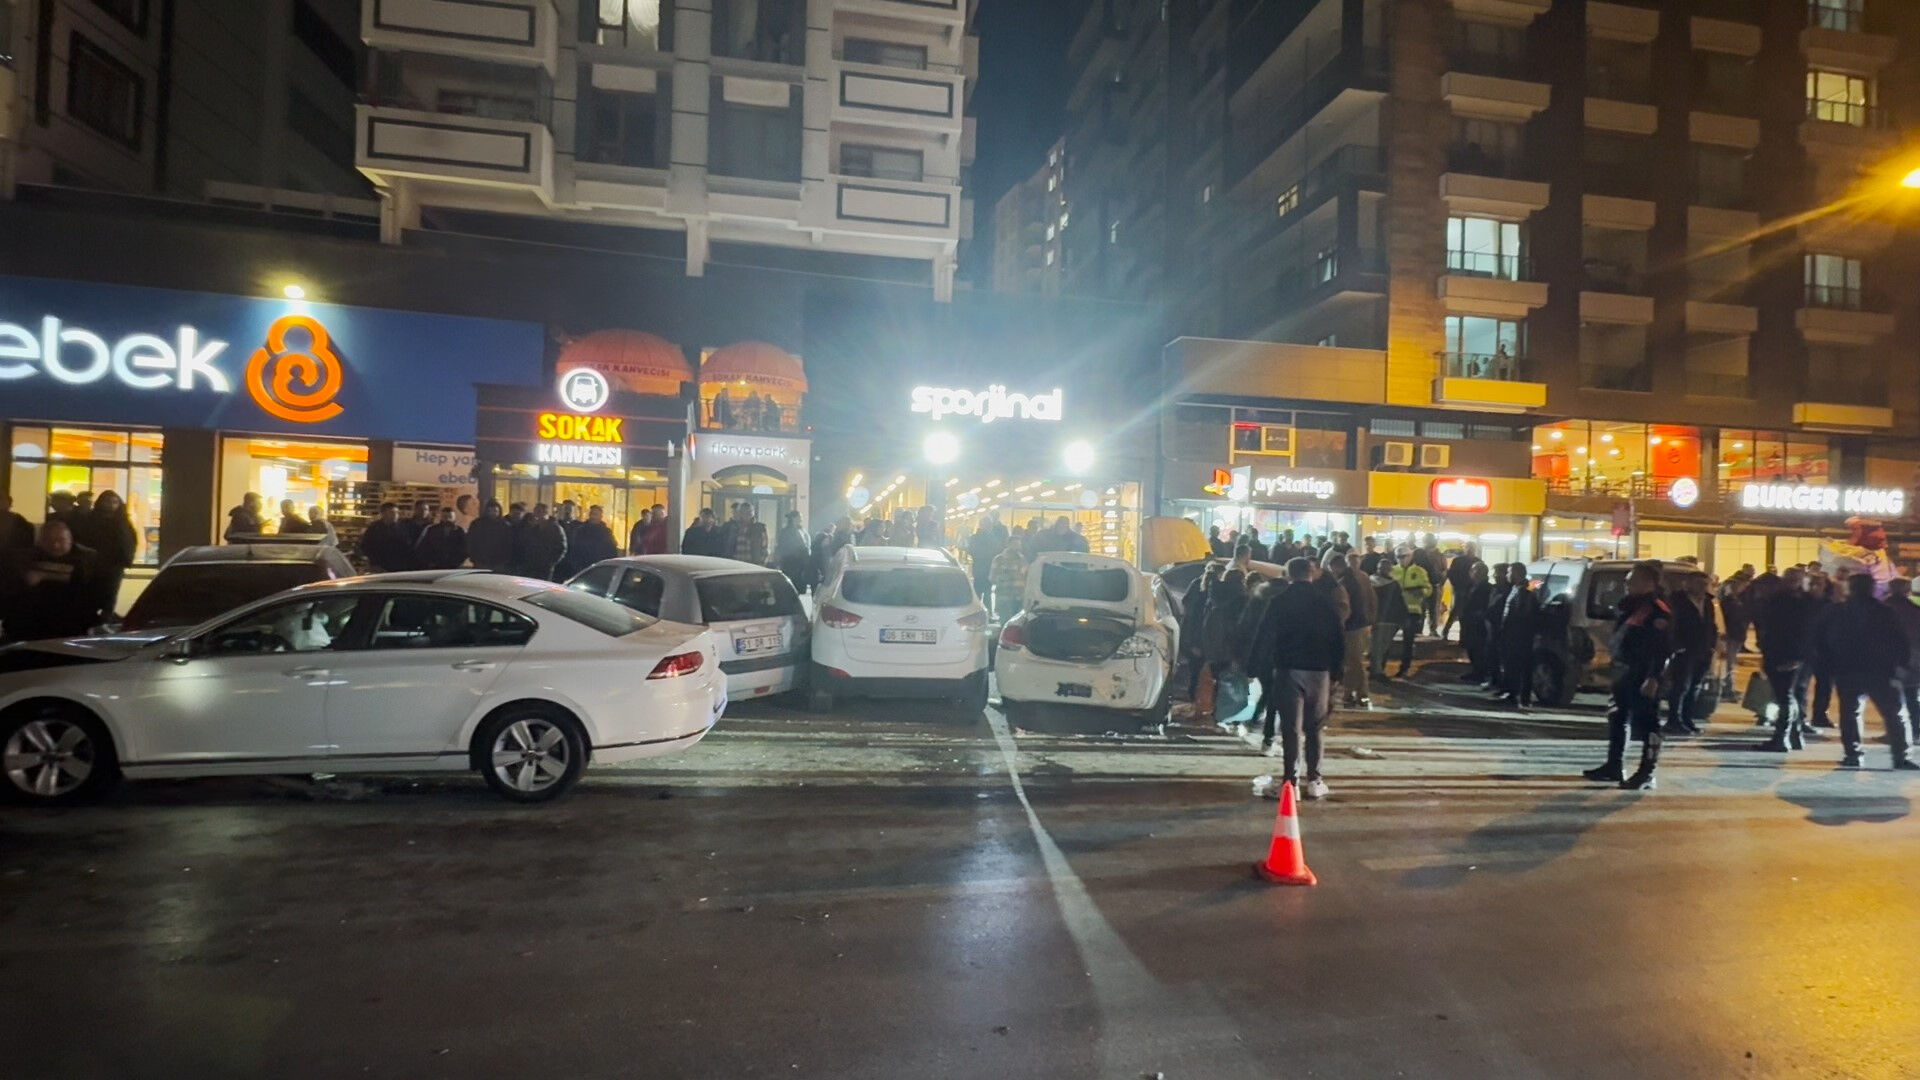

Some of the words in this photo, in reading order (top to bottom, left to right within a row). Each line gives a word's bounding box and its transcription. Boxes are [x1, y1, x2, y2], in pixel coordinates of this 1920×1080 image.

[0, 314, 230, 393] ebek
[911, 384, 1062, 424] sporjinal
[538, 412, 623, 443] SOKAK
[415, 450, 448, 465] Hep
[711, 441, 752, 458] florya
[755, 446, 787, 459] park
[1742, 483, 1840, 512] BURGER
[1844, 488, 1905, 515] KING
